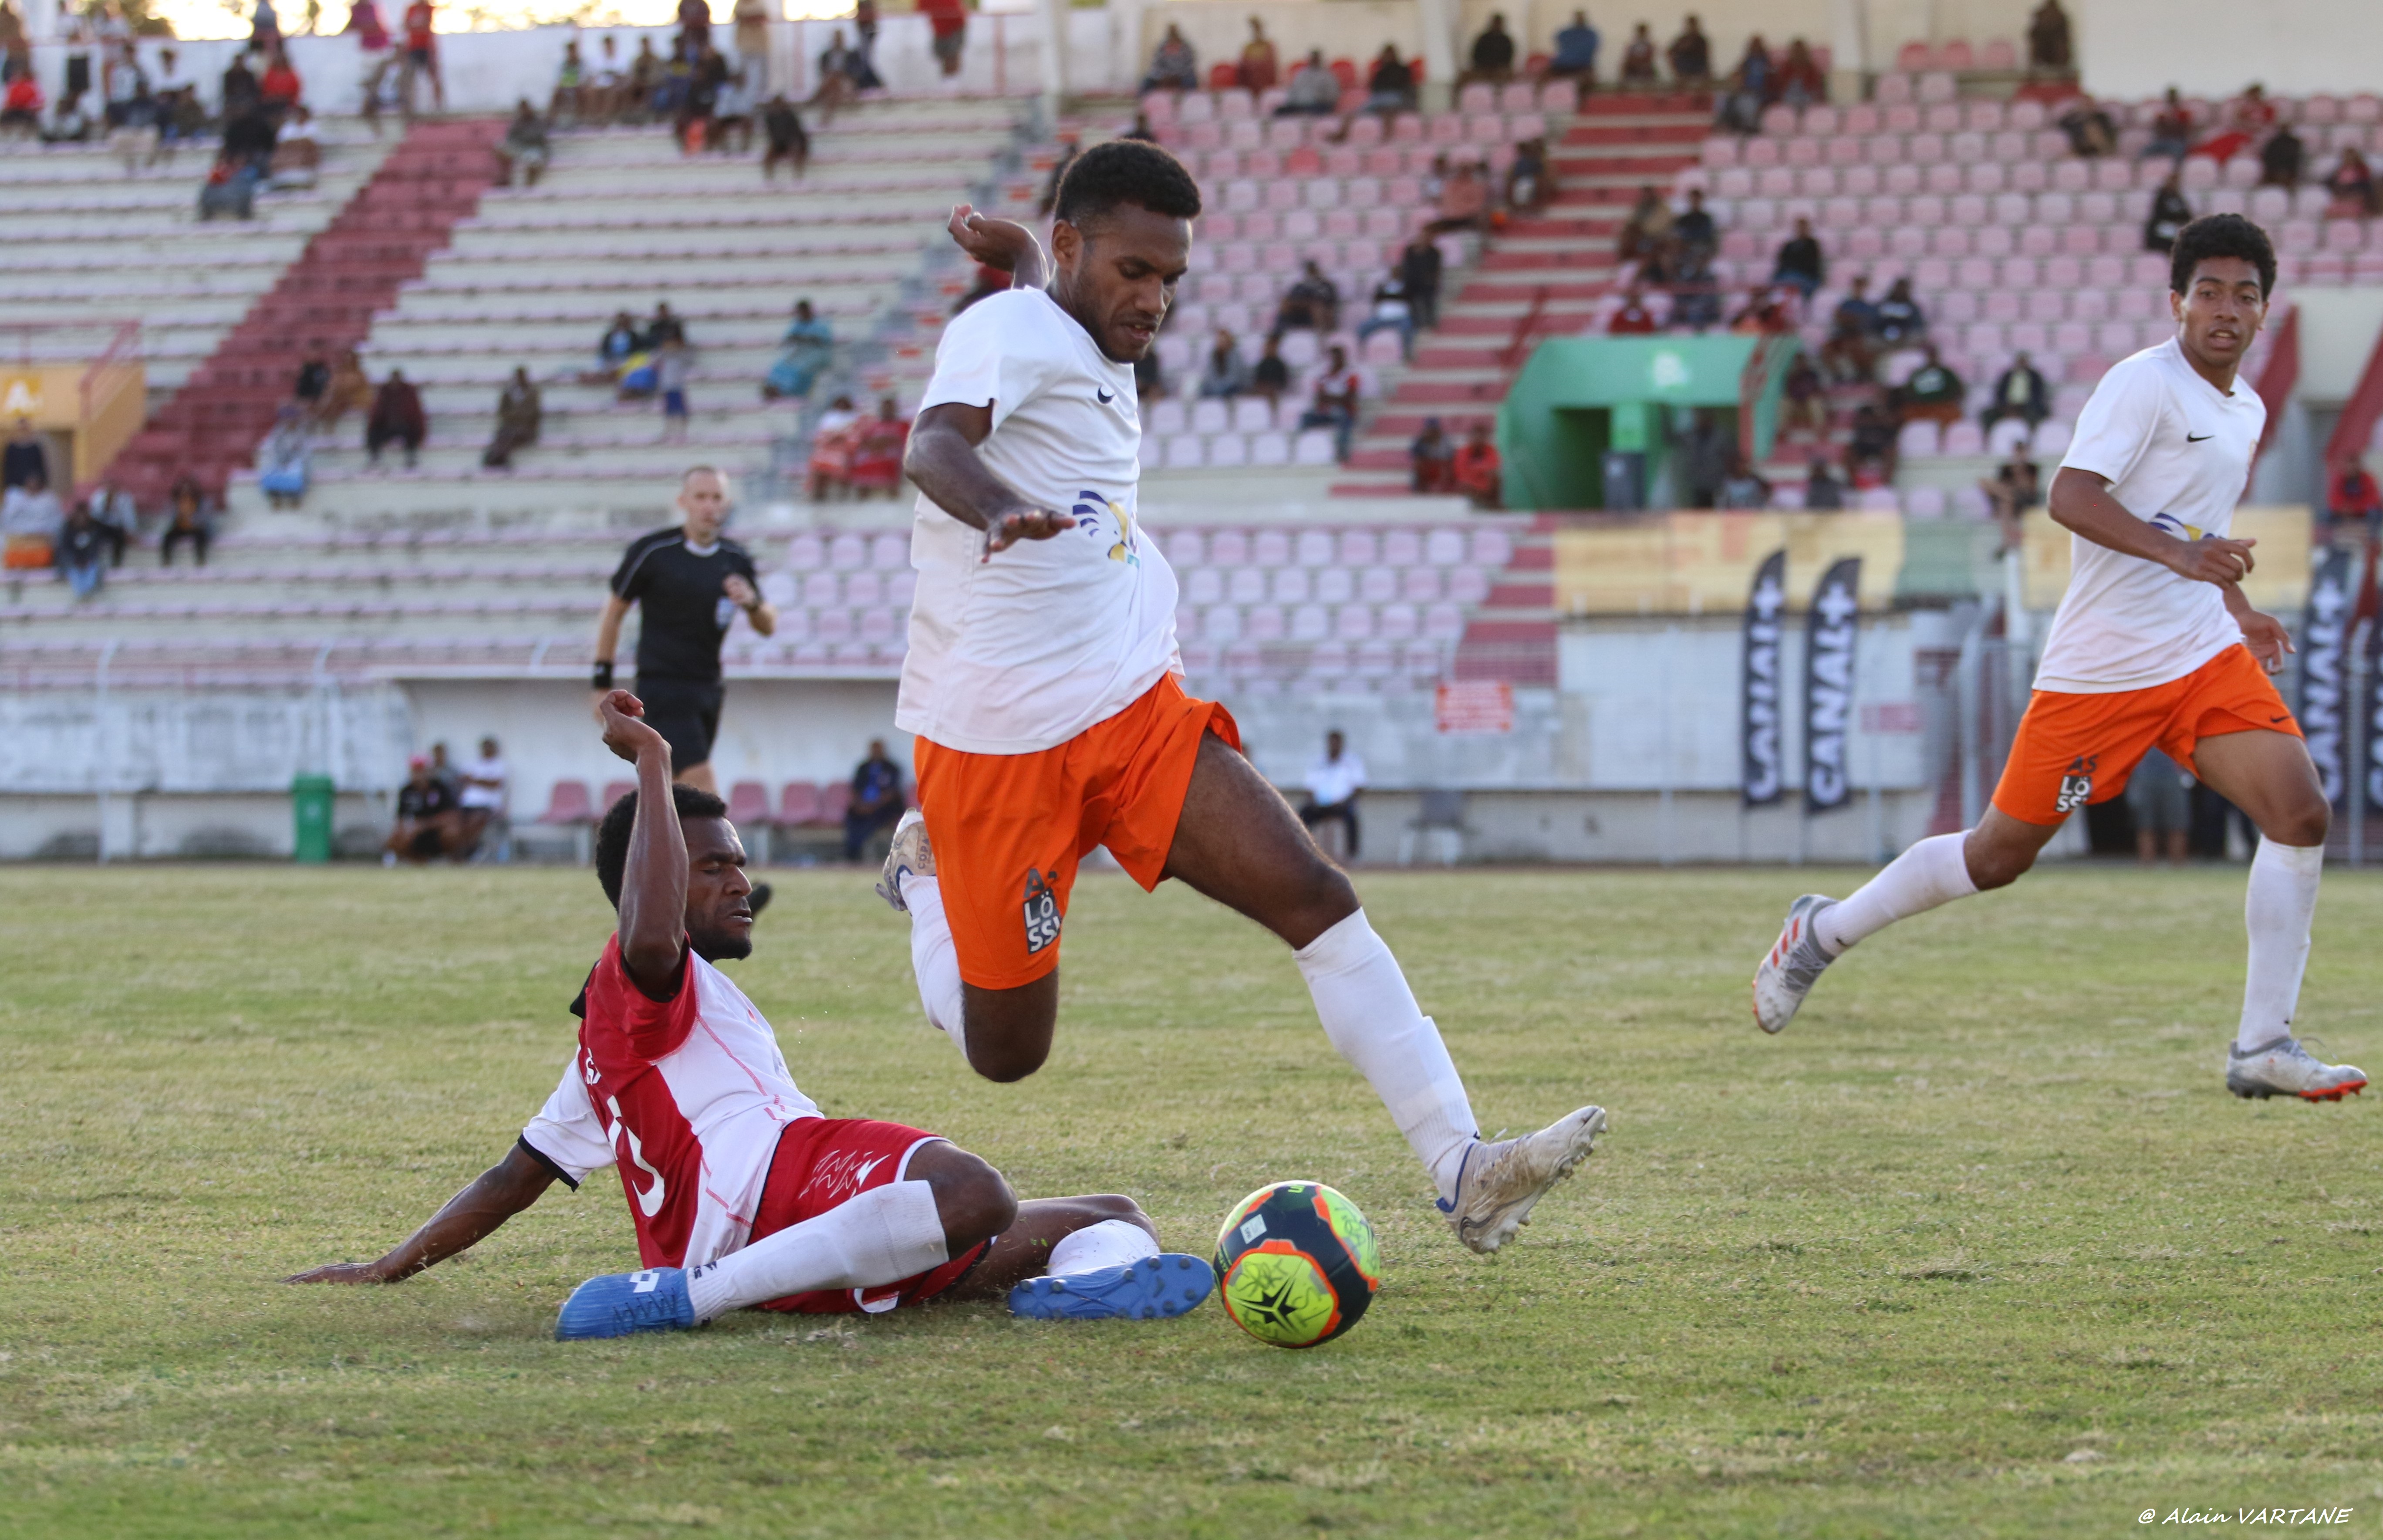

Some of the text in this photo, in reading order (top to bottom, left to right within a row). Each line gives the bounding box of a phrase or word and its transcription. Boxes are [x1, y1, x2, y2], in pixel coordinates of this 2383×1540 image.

[1810, 582, 1856, 804] CANAL+
[2066, 754, 2099, 773] AS
[918, 838, 930, 869] COPA
